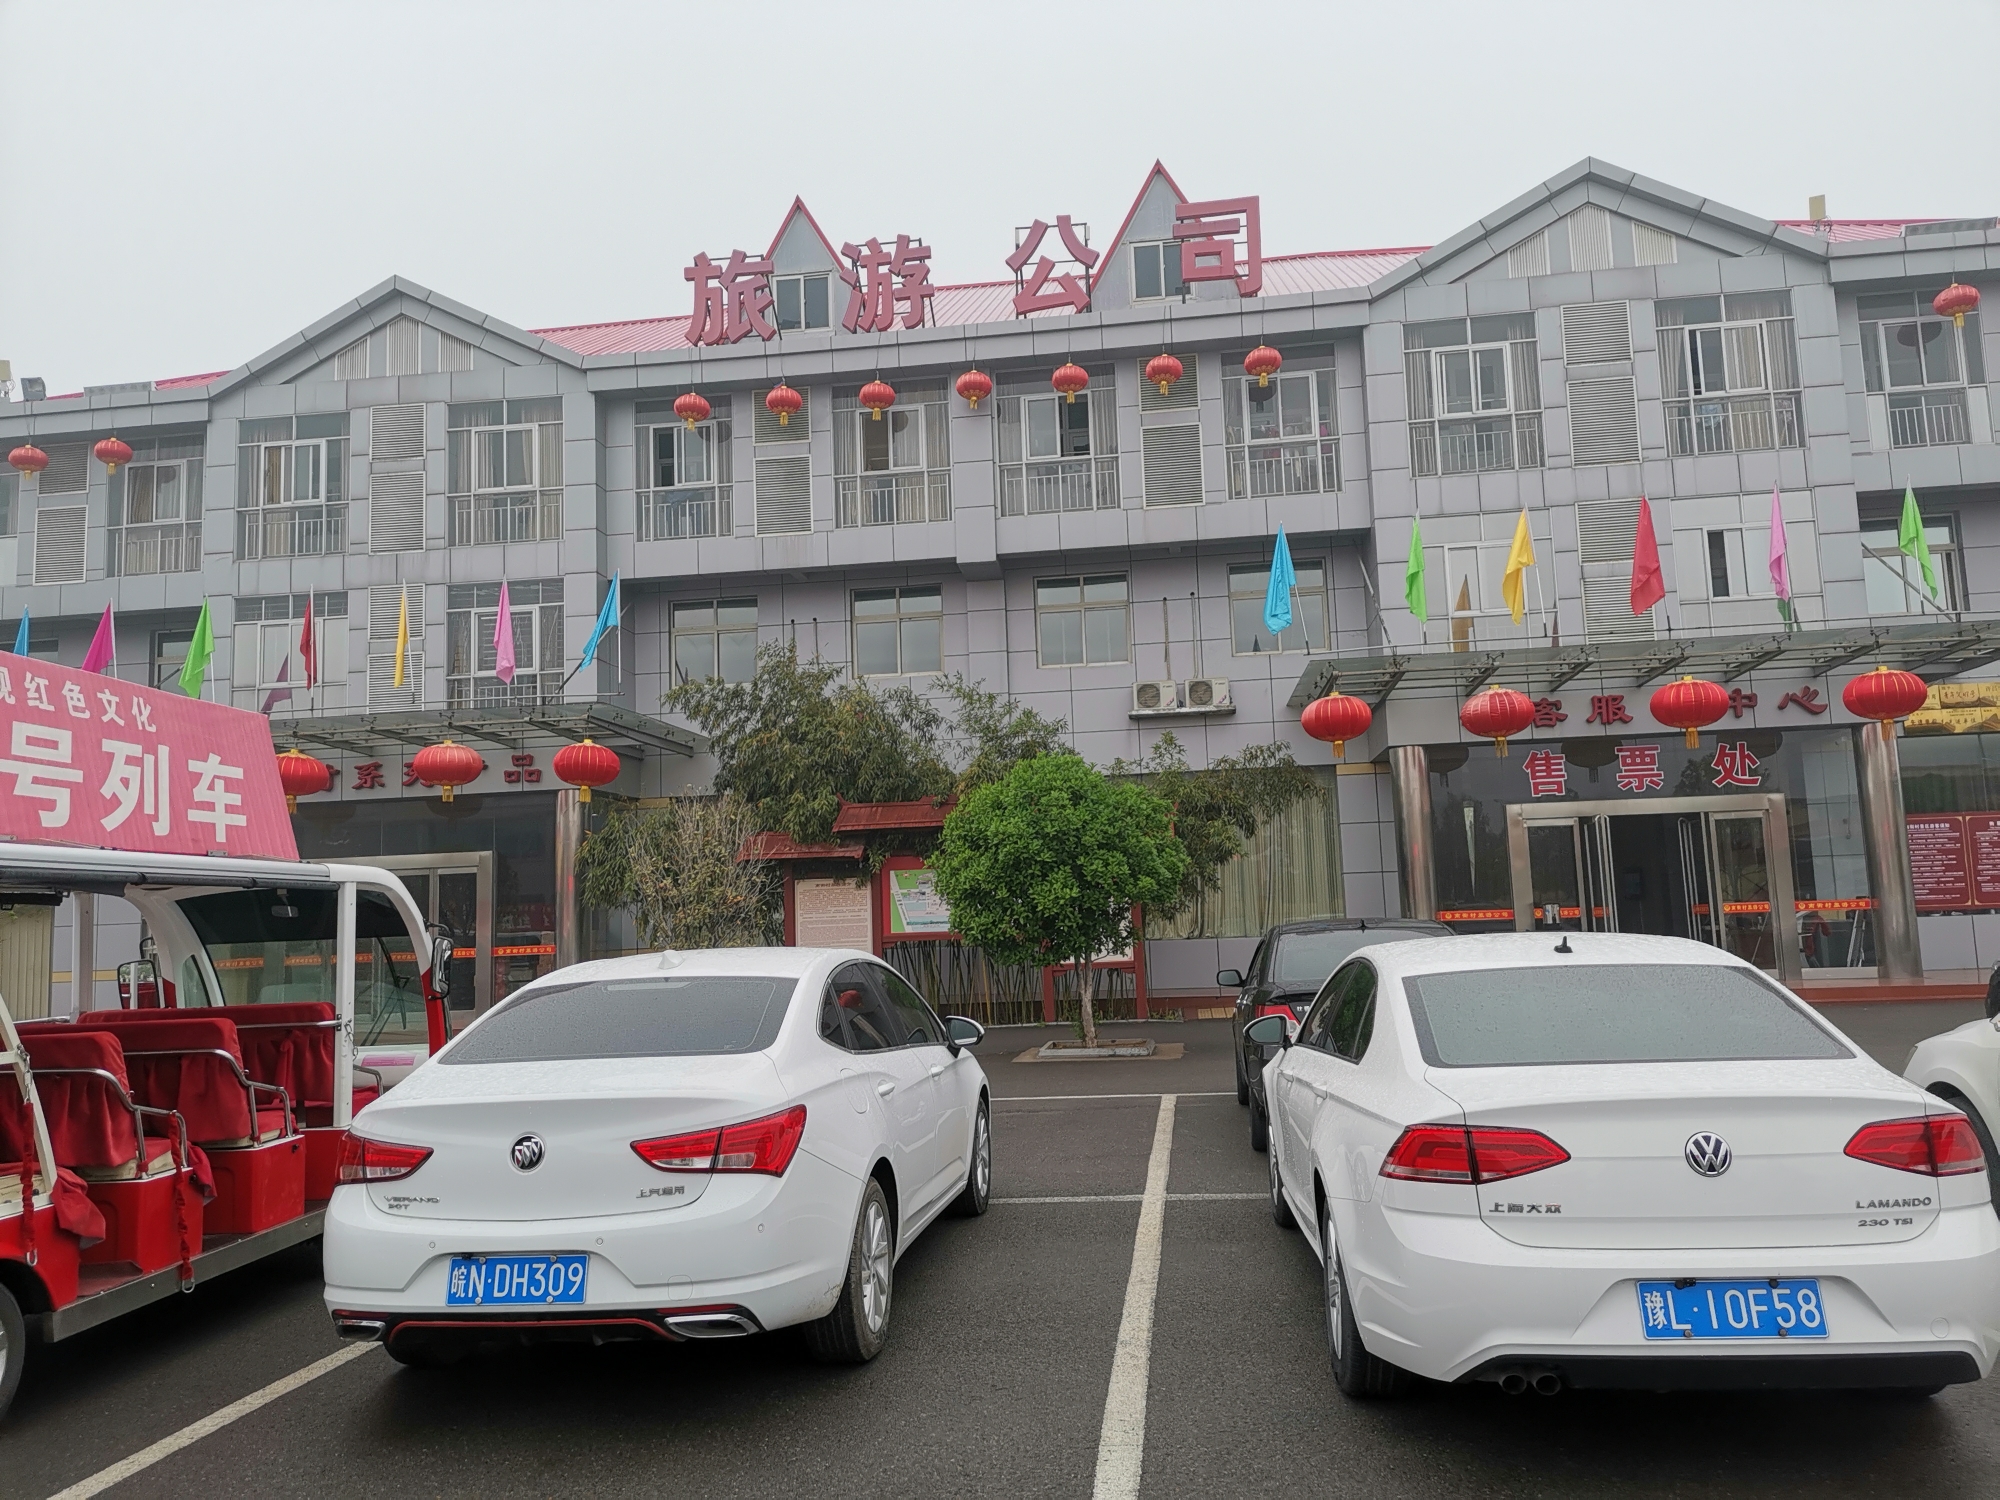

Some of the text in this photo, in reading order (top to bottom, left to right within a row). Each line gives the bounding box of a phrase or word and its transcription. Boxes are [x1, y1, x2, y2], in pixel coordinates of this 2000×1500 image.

[683, 195, 1262, 347] 旅游公司
[1532, 685, 1829, 728] 客服中心
[1522, 741, 1761, 797] 售票处
[1489, 1202, 1562, 1213] 上海大众
[1855, 1197, 1932, 1209] LAMANDO
[1858, 1218, 1889, 1227] 230
[450, 1262, 584, 1299] 皖N·DH309
